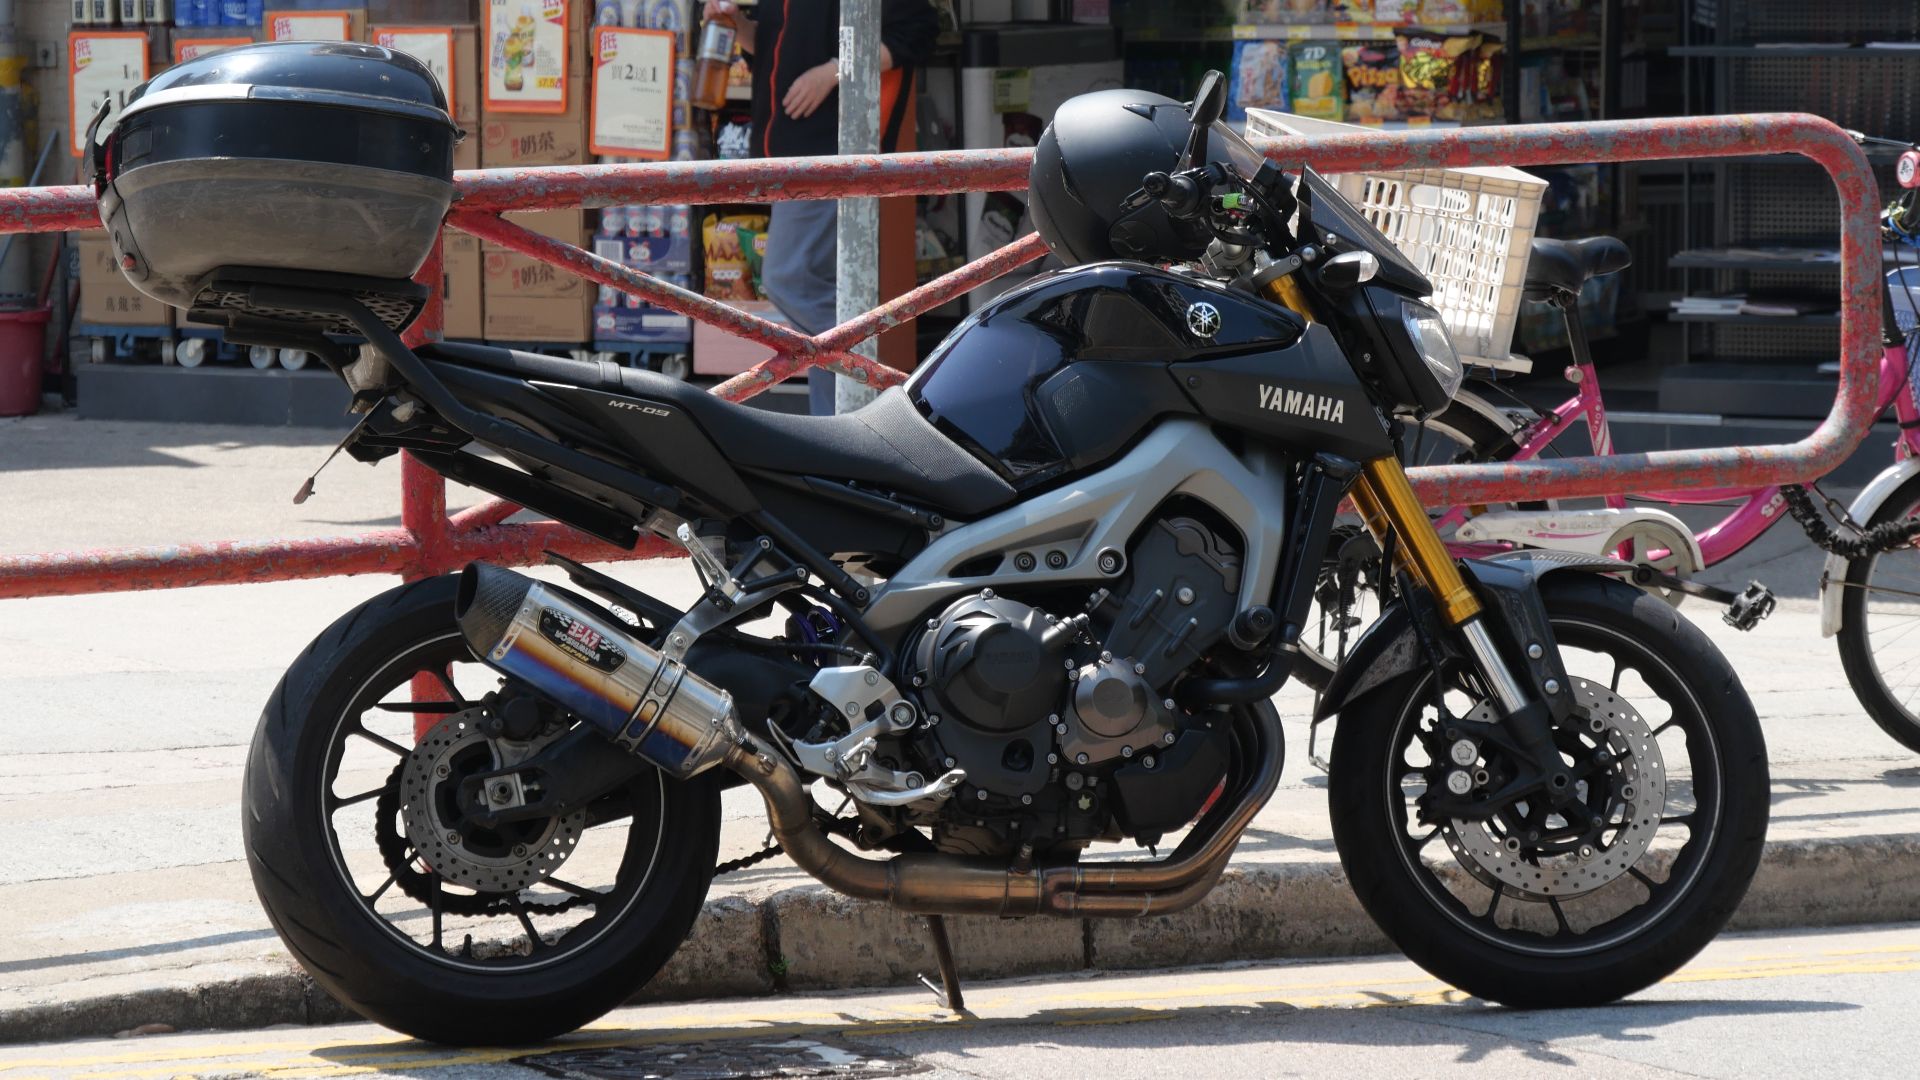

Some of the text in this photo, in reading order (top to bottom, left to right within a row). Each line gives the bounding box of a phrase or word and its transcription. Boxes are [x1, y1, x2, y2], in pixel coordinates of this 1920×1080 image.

[608, 400, 671, 417] MT-09
[1259, 384, 1345, 424] YAMAHA
[554, 629, 601, 663] YOSHIMURA
[566, 620, 600, 648] ヨシムラ
[559, 643, 590, 662] JAPAN
